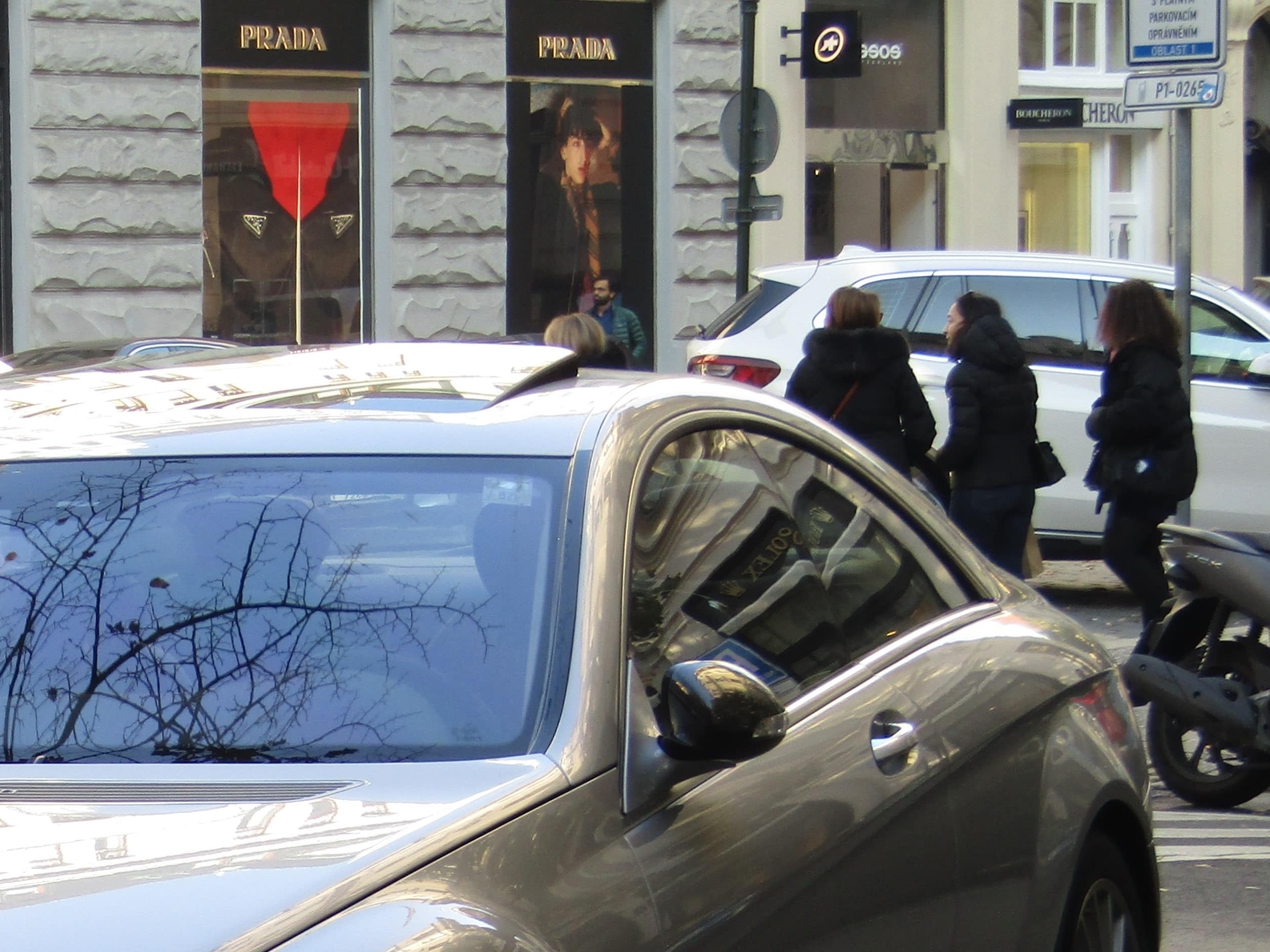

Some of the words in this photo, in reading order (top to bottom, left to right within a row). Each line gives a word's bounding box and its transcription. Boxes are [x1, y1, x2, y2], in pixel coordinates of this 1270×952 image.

[1148, 8, 1197, 23] PARKOVACÍM
[239, 25, 327, 51] PRADA
[538, 36, 617, 60] PRADA
[1151, 45, 1187, 56] OBLAST
[1016, 109, 1072, 118] BOUCHERON
